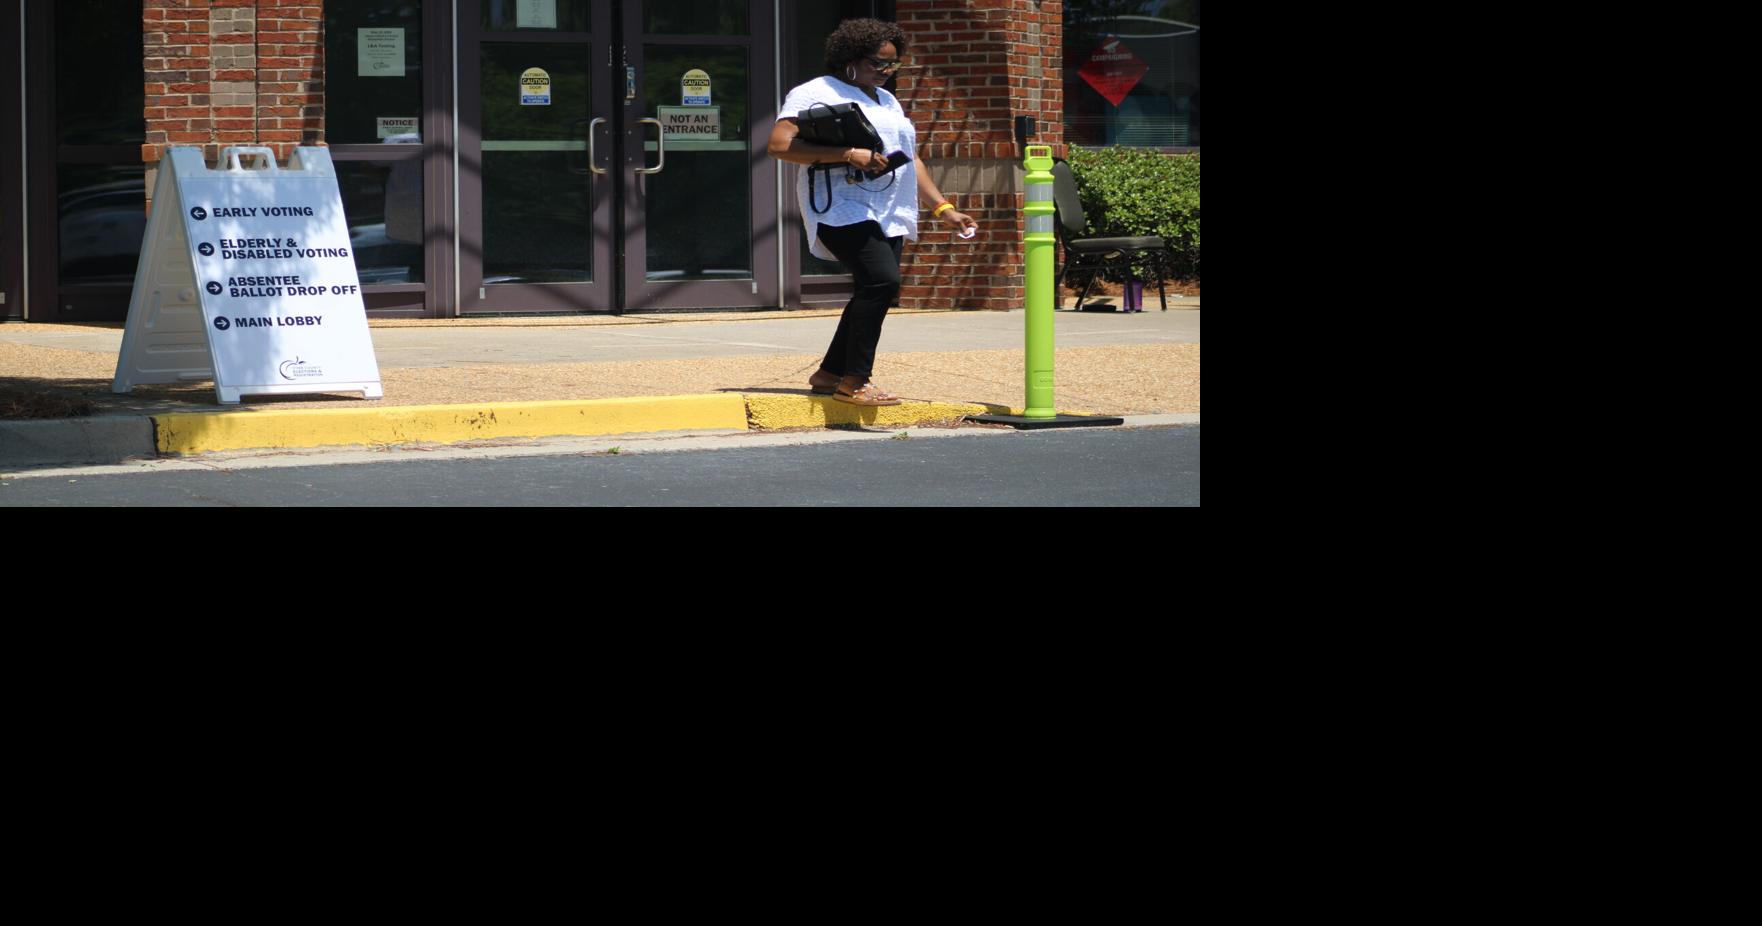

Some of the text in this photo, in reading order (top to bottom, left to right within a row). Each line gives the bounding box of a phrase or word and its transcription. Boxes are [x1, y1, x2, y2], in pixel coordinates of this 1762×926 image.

[670, 114, 709, 123] NOT AN
[663, 125, 718, 134] ENTRANCE
[213, 206, 314, 218] EARLY VOTING
[219, 238, 298, 249] ELDERLY &
[222, 248, 348, 260] DISABLED VOTING
[228, 276, 301, 287] ABSENTEE
[230, 285, 358, 298] BALLOT DROP OFF
[235, 315, 323, 328] MAIN LOBBY
